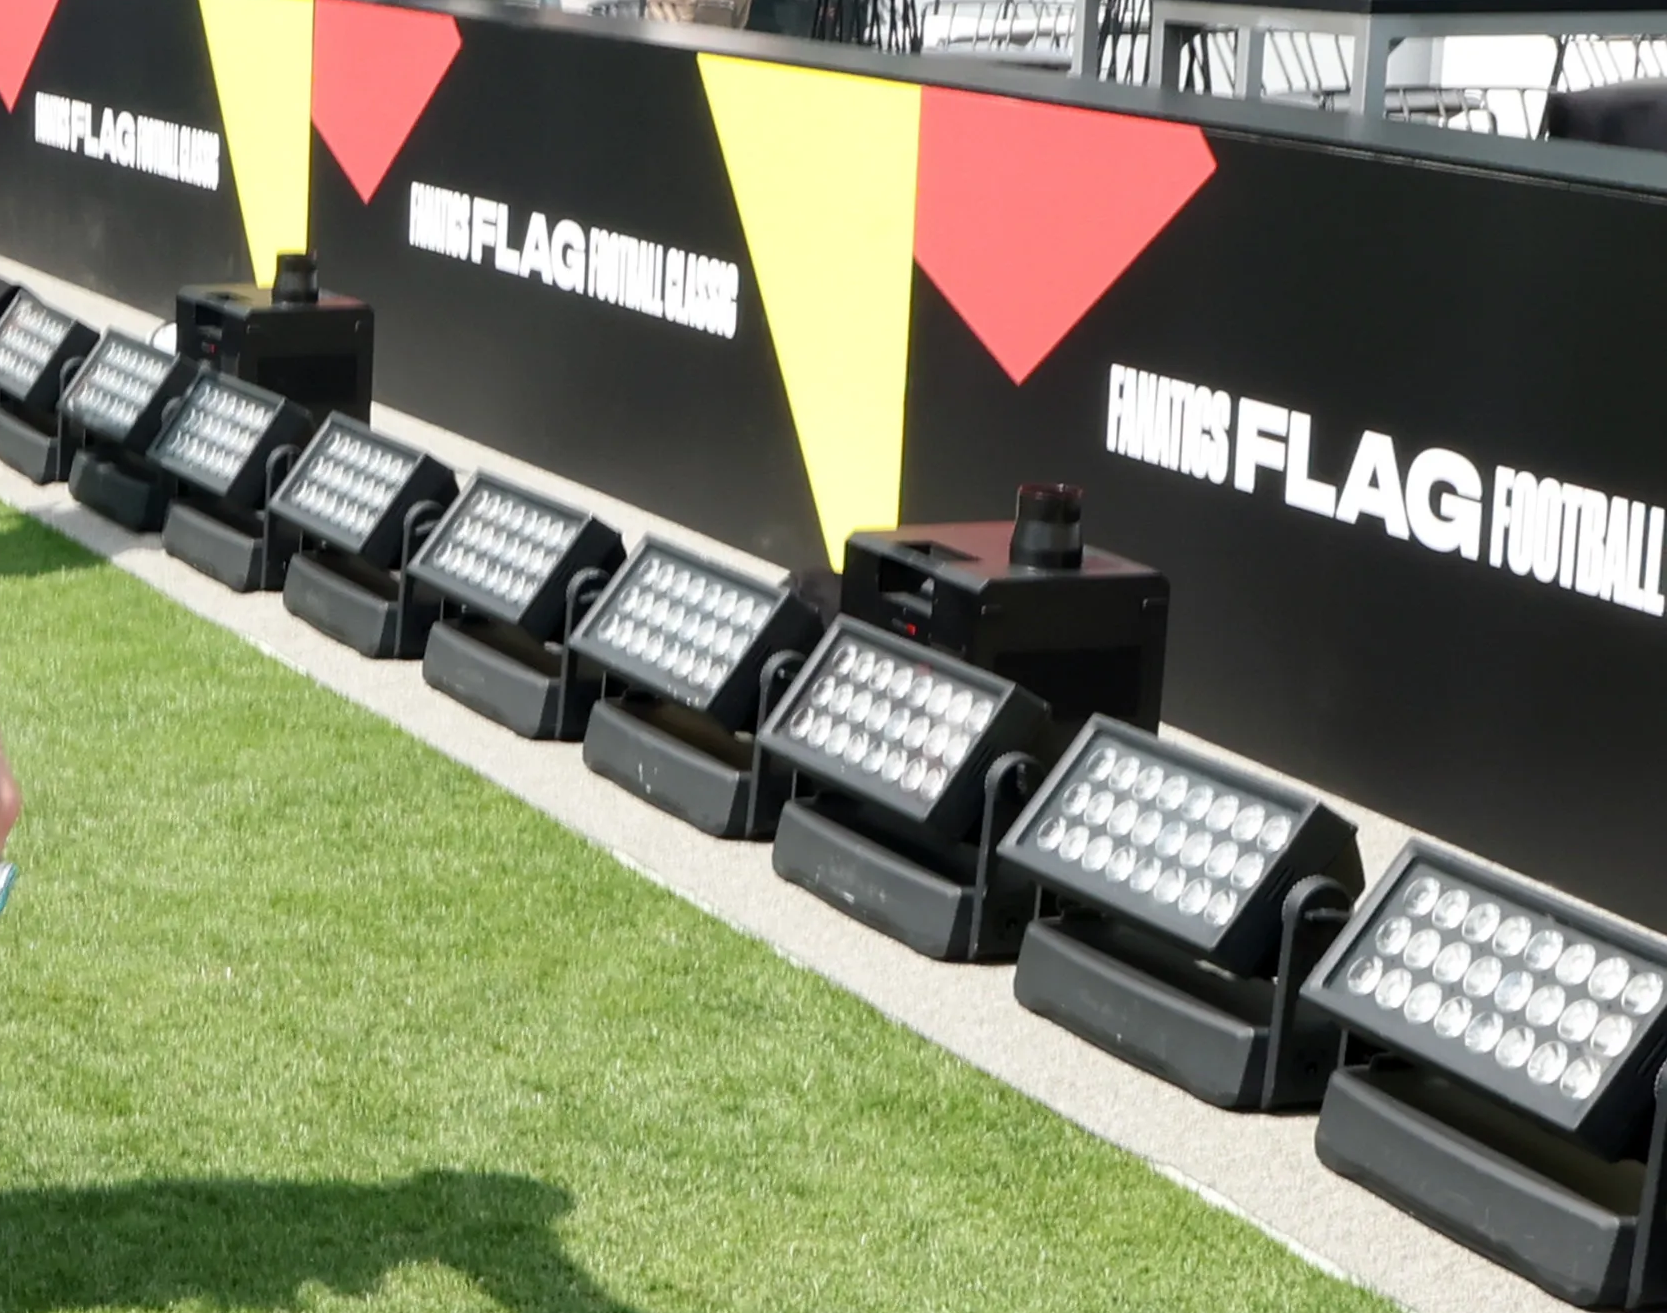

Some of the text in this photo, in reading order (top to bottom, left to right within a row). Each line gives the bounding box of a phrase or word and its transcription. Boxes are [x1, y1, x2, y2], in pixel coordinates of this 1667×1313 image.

[71, 99, 136, 169] FLAG
[471, 196, 586, 295] FLAG
[587, 226, 664, 319] FOOTBALL
[664, 247, 740, 340] CLASSIC
[1106, 363, 1666, 618] FANATICS FLAG FOOTBALL
